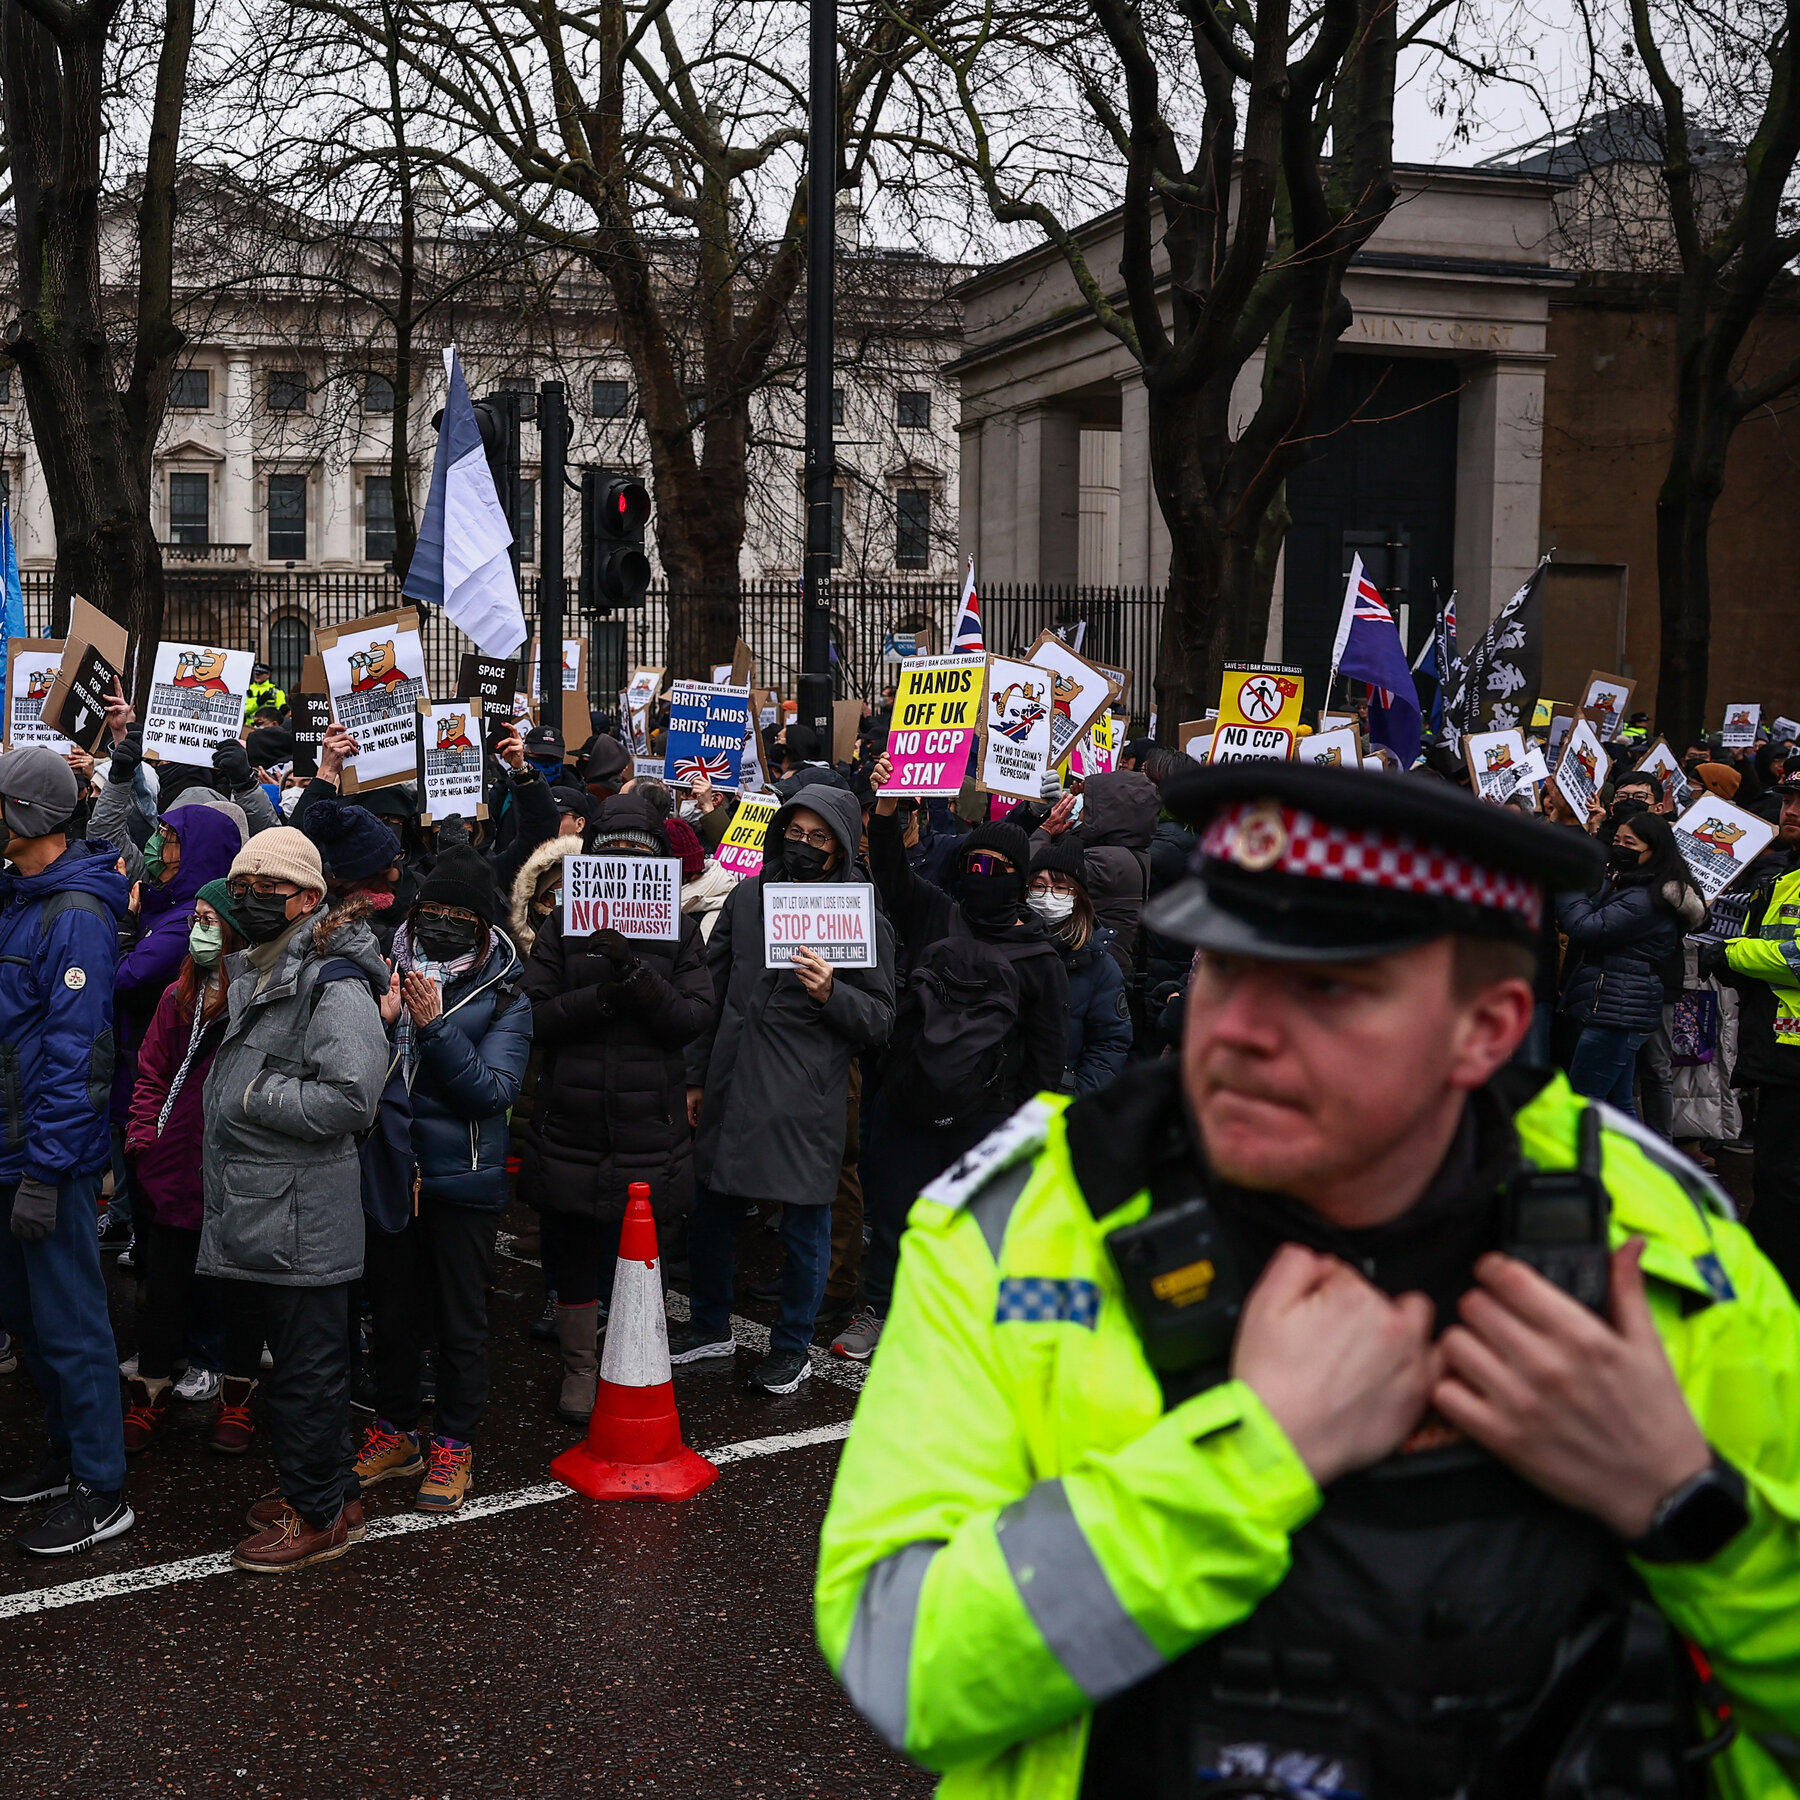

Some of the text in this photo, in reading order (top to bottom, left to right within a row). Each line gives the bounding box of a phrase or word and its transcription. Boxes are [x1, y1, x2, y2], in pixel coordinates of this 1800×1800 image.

[1358, 318, 1513, 345] MINT COURT
[817, 577, 830, 586] B9
[817, 588, 830, 596] TL
[903, 656, 985, 668] SAVE BAN CHINA'S EMBASSY
[1261, 664, 1281, 672] CHINA'S
[1281, 666, 1302, 674] EMBASSY
[93, 660, 111, 683] SPACE
[478, 664, 505, 678] SPACE
[89, 677, 101, 694] FOR
[480, 683, 497, 695] FOR
[727, 687, 748, 695] EMBASSY
[909, 670, 972, 695] HANDS
[73, 681, 105, 719] FREE SPEECH
[307, 700, 329, 710] SPAC
[672, 691, 712, 708] BRITS'
[1472, 686, 1480, 717] KONG
[312, 717, 328, 726] FOR
[903, 702, 968, 726] OFF UK
[14, 723, 26, 731] CCP
[28, 723, 33, 731] IS
[149, 718, 237, 739] CCP IS WATCHING YOU
[362, 729, 370, 739] IS
[373, 718, 412, 736] WATCHING
[669, 717, 709, 734] BRITS'
[146, 731, 163, 741] STOP
[165, 733, 177, 744] THE
[179, 736, 200, 747] MEGA
[295, 732, 315, 742] FREE
[363, 743, 375, 753] THE
[378, 738, 399, 749] MEGA
[894, 730, 965, 755] NO CCP
[1095, 729, 1108, 747] UK
[1224, 728, 1284, 748] NO CCP
[993, 744, 1042, 762] SAY NO TO CHINA'S
[995, 755, 1036, 771] TRANSNATIONAL
[428, 778, 438, 786] CCP
[446, 775, 472, 785] WATCHING
[900, 762, 946, 786] STAY
[1000, 766, 1031, 781] REPRESSION
[429, 789, 439, 798] STOP
[448, 787, 462, 796] MEGA
[742, 805, 775, 824] HAND
[731, 826, 755, 844] OFF
[718, 846, 764, 868] NO CCP
[572, 861, 671, 882] STAND TALL
[1711, 876, 1724, 887] YOU
[572, 880, 671, 901] STAND FREE
[773, 896, 787, 909] DON'T
[788, 896, 797, 909] LET
[798, 896, 809, 909] OUR
[810, 896, 822, 909] MINT
[823, 896, 836, 909] LOSE
[846, 896, 861, 909] SHINE
[1713, 900, 1743, 918] FRO
[572, 900, 671, 930] NO CHINESE
[612, 920, 671, 934] EMBASSY!
[772, 914, 863, 940] STOP CHINA
[772, 946, 793, 960] FROM
[831, 946, 844, 959] THE
[846, 946, 865, 959] LINE!
